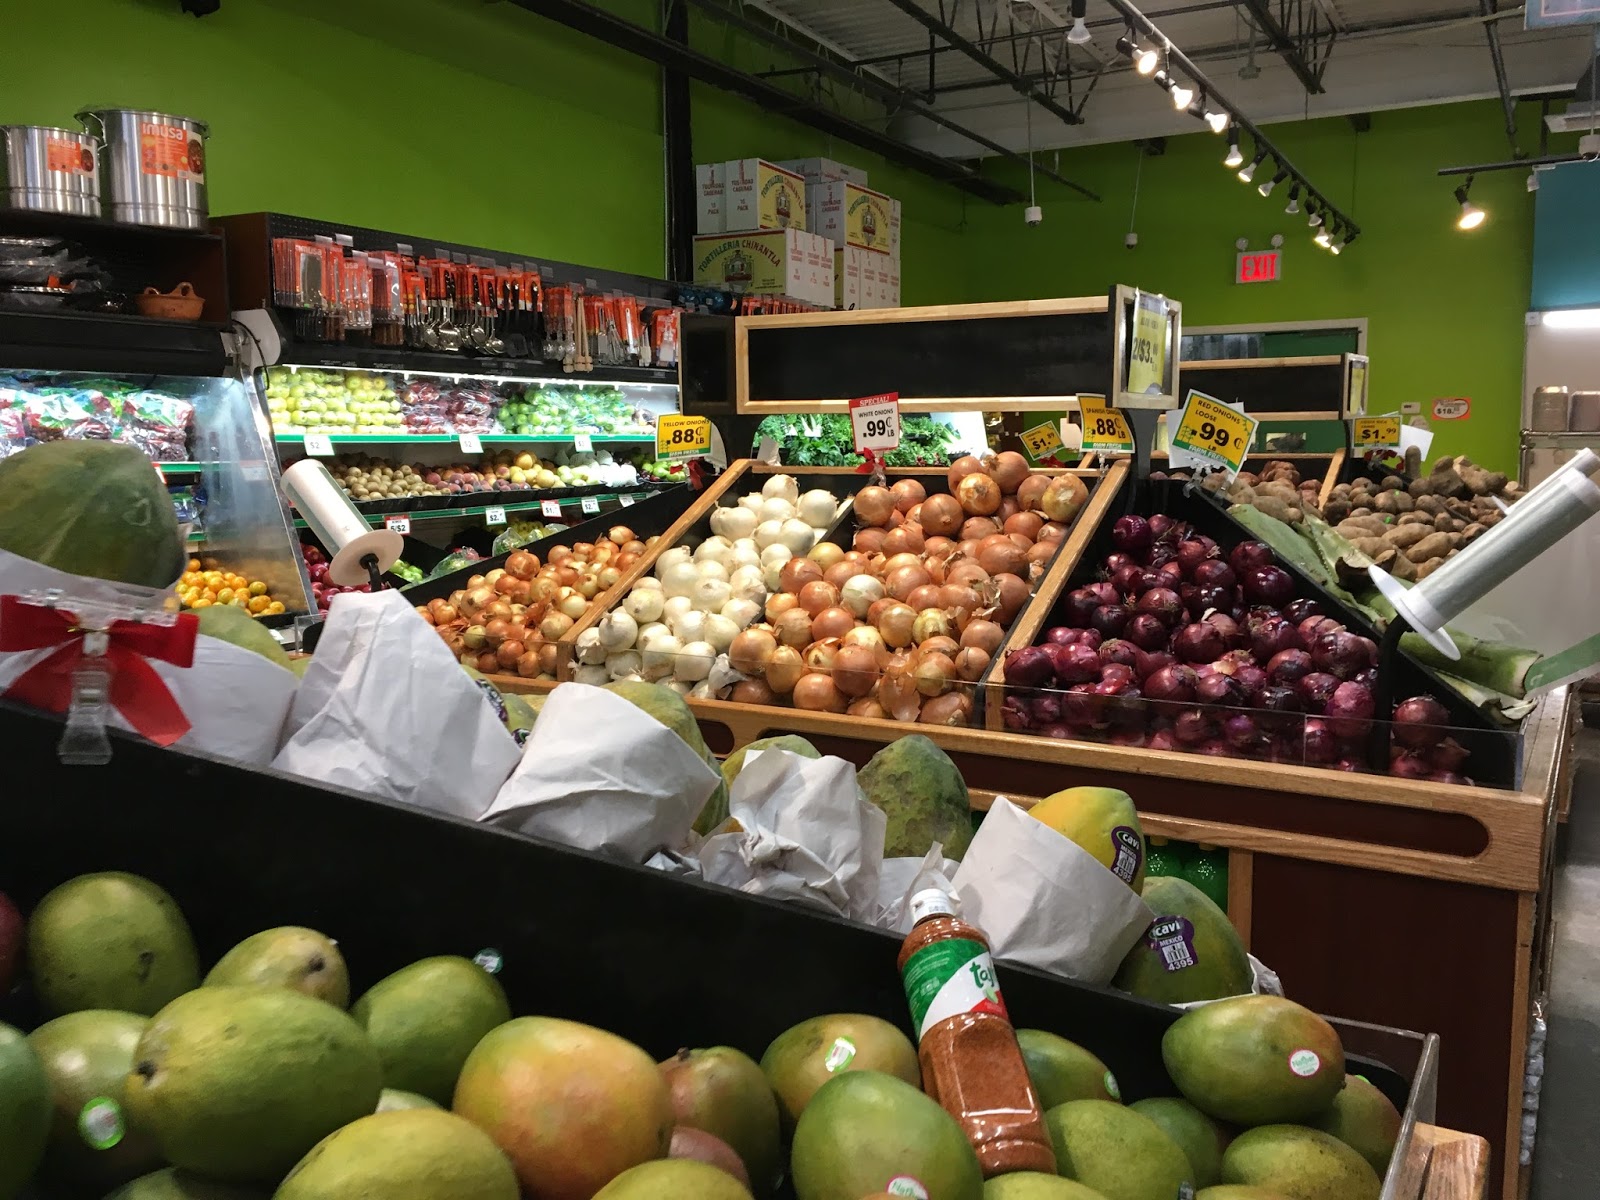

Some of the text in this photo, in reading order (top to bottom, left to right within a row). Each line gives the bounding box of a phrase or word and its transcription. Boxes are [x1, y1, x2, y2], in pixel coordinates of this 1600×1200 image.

[143, 123, 183, 141] imusa
[698, 240, 781, 272] TORTILLERIA CHINANTLA
[1241, 253, 1278, 282] EXIT
[860, 396, 890, 406] SPECIAL!
[858, 408, 894, 418] WHITE ONIONS
[1195, 409, 1217, 422] LOOSE
[1197, 400, 1241, 424] RED ONIONS
[887, 429, 895, 437] LB
[1118, 430, 1126, 439] LB
[696, 437, 705, 445] LB
[1121, 832, 1140, 850] cavi
[1120, 845, 1137, 859] MEXICO
[1113, 866, 1133, 883] 4395
[1154, 920, 1181, 937] cavi
[1159, 935, 1184, 947] MEXICO
[1168, 957, 1194, 972] 4395
